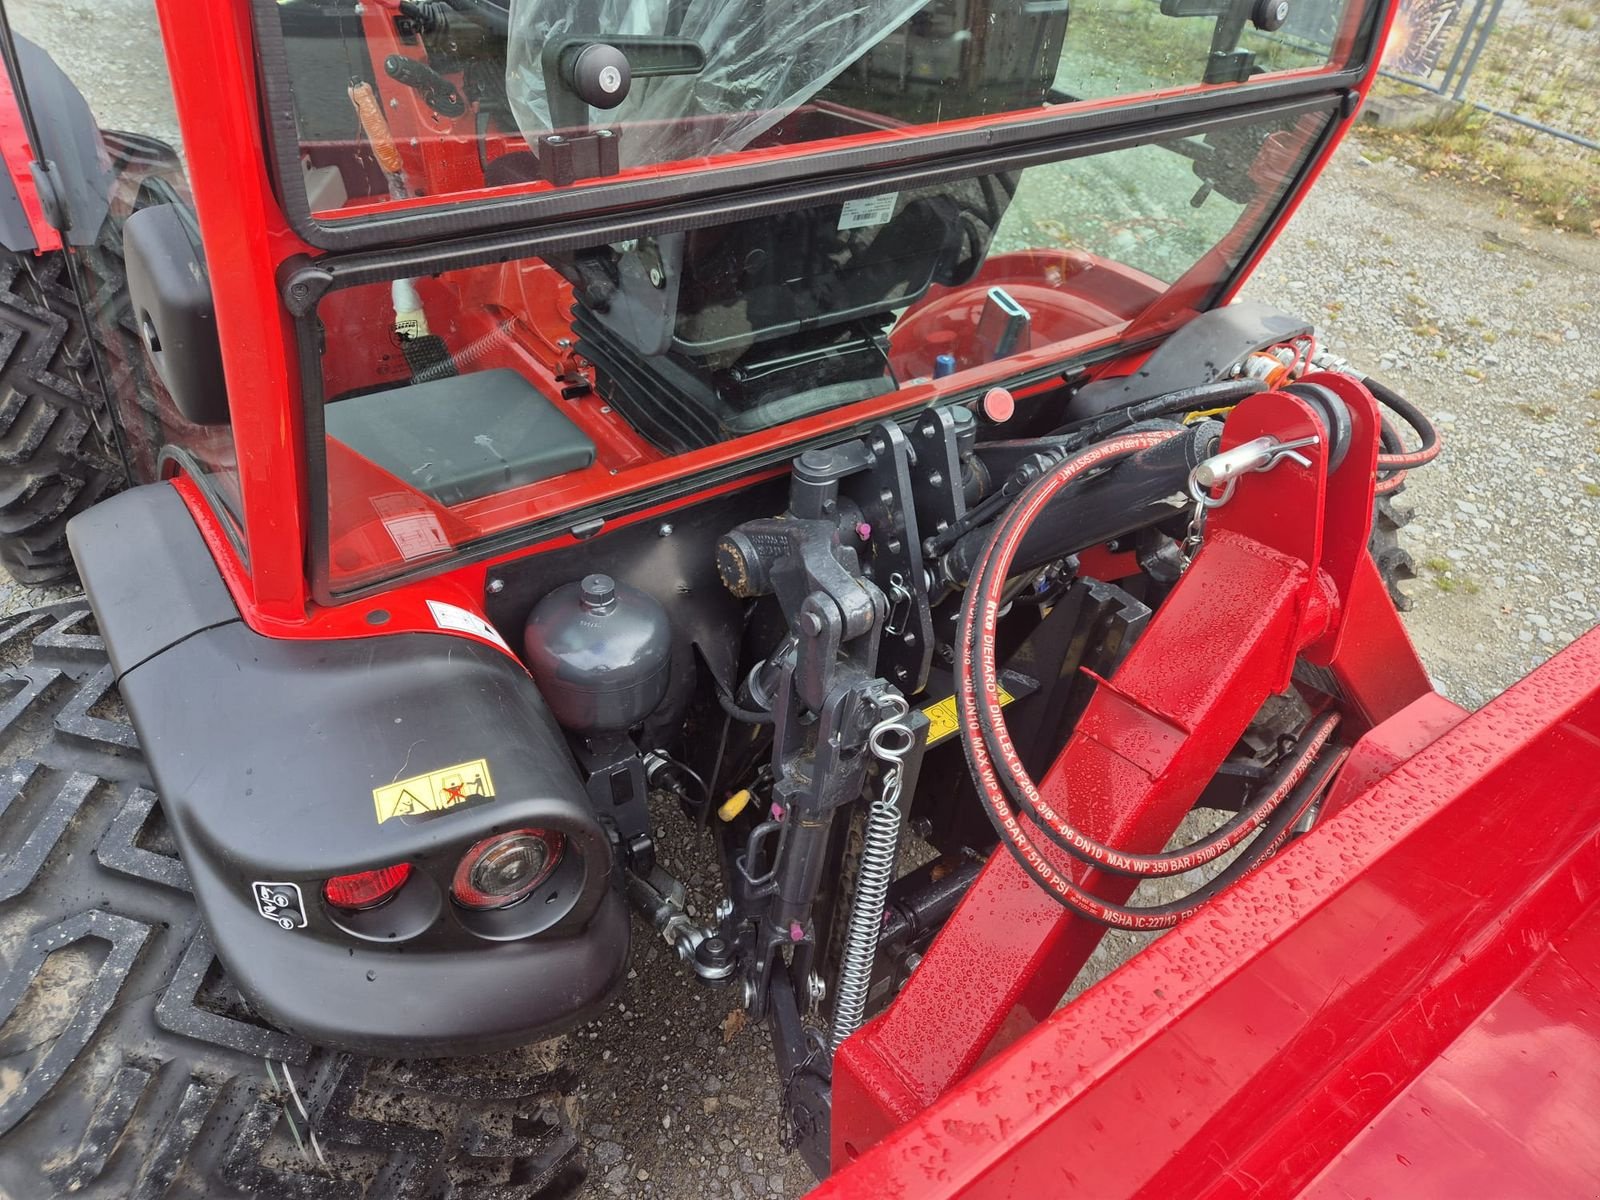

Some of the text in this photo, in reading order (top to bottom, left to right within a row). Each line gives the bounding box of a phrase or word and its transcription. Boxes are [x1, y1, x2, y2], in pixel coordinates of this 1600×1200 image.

[1101, 438, 1139, 456] ABRASION
[1059, 449, 1101, 481] RESISTANT
[965, 697, 980, 730] DN10
[972, 737, 990, 767] MAX
[982, 768, 998, 791] WP
[990, 704, 1016, 761] DINFLEX
[1011, 762, 1040, 802] DF26D
[1037, 801, 1058, 820] 3/8"
[1058, 824, 1074, 840] -06
[1074, 836, 1103, 859] DN10
[1106, 854, 1131, 871] MAX
[1132, 861, 1150, 873] WP
[1152, 862, 1169, 873] 350
[1170, 857, 1190, 871] BAR
[1196, 846, 1216, 864] 5100
[1215, 838, 1231, 853] PSI
[992, 793, 1009, 817] 350
[1252, 801, 1275, 825] MSHA
[1004, 817, 1026, 847] BAR
[1251, 830, 1287, 871] RESISTANT
[1027, 851, 1051, 878] 5100
[1049, 875, 1070, 895] PSI
[1102, 909, 1133, 927] MSHA
[1135, 915, 1177, 928] IC-227/12
